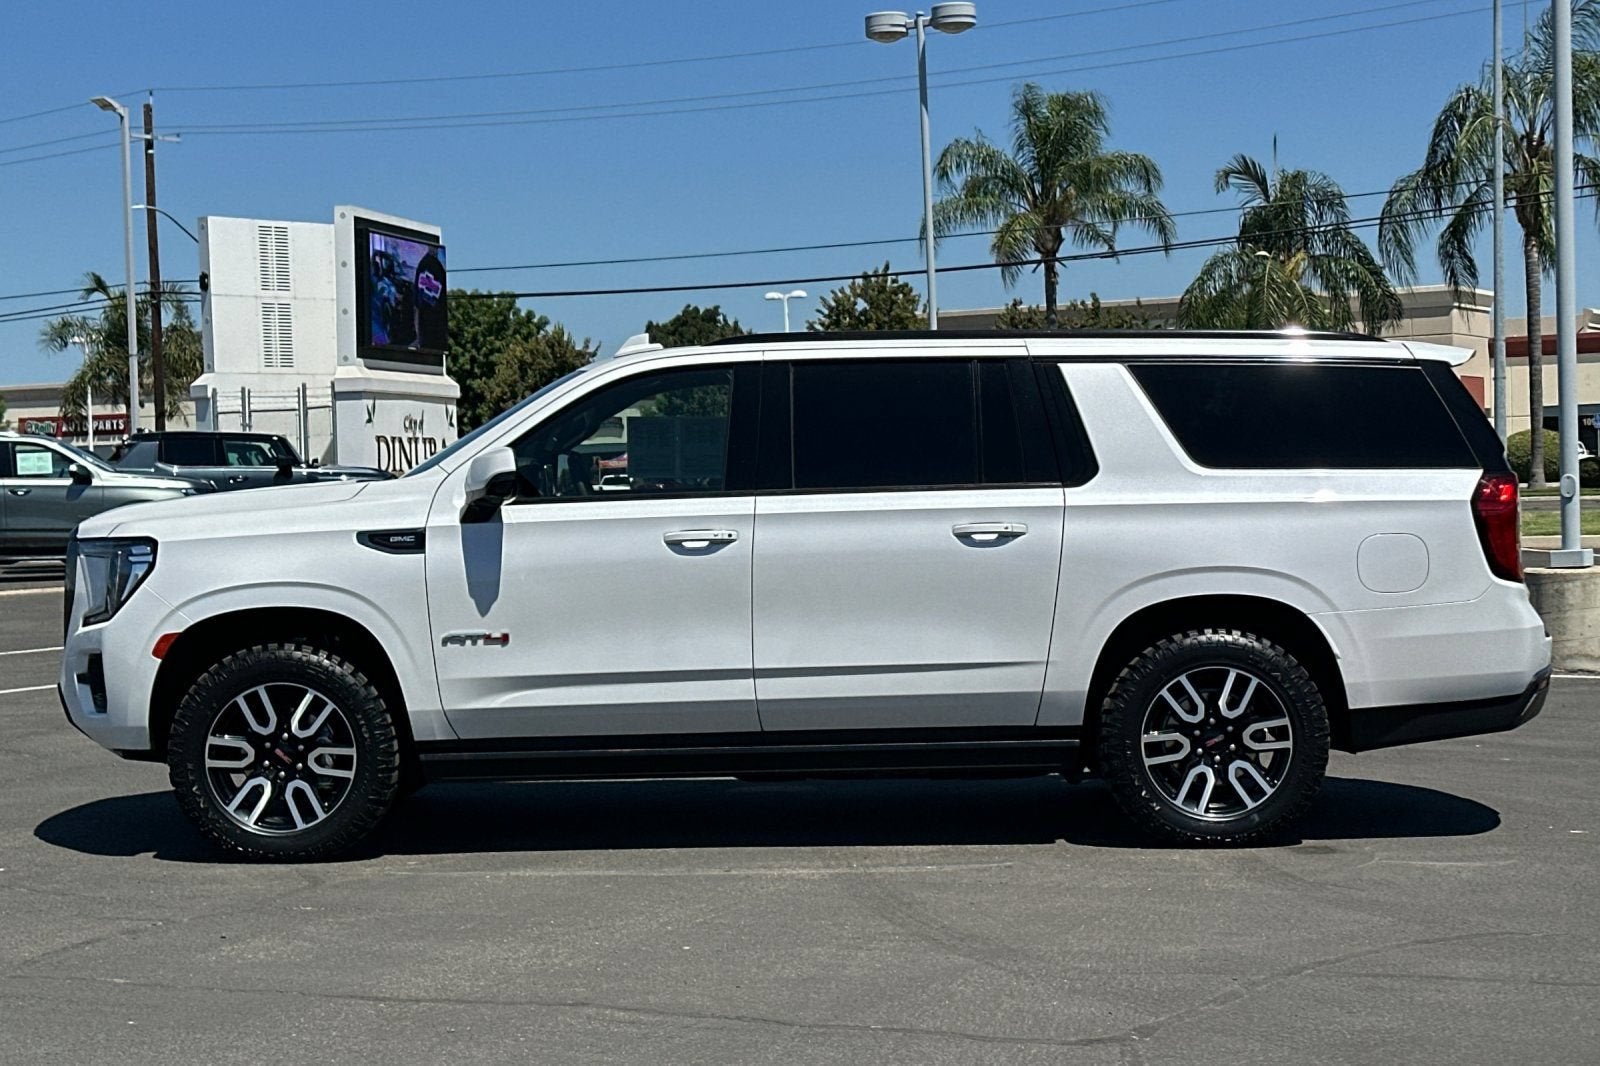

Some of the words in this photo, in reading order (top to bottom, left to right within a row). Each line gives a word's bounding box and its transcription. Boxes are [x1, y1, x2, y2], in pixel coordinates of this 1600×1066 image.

[93, 419, 125, 431] PARTS
[389, 535, 416, 543] GMC
[441, 629, 510, 648] AT4
